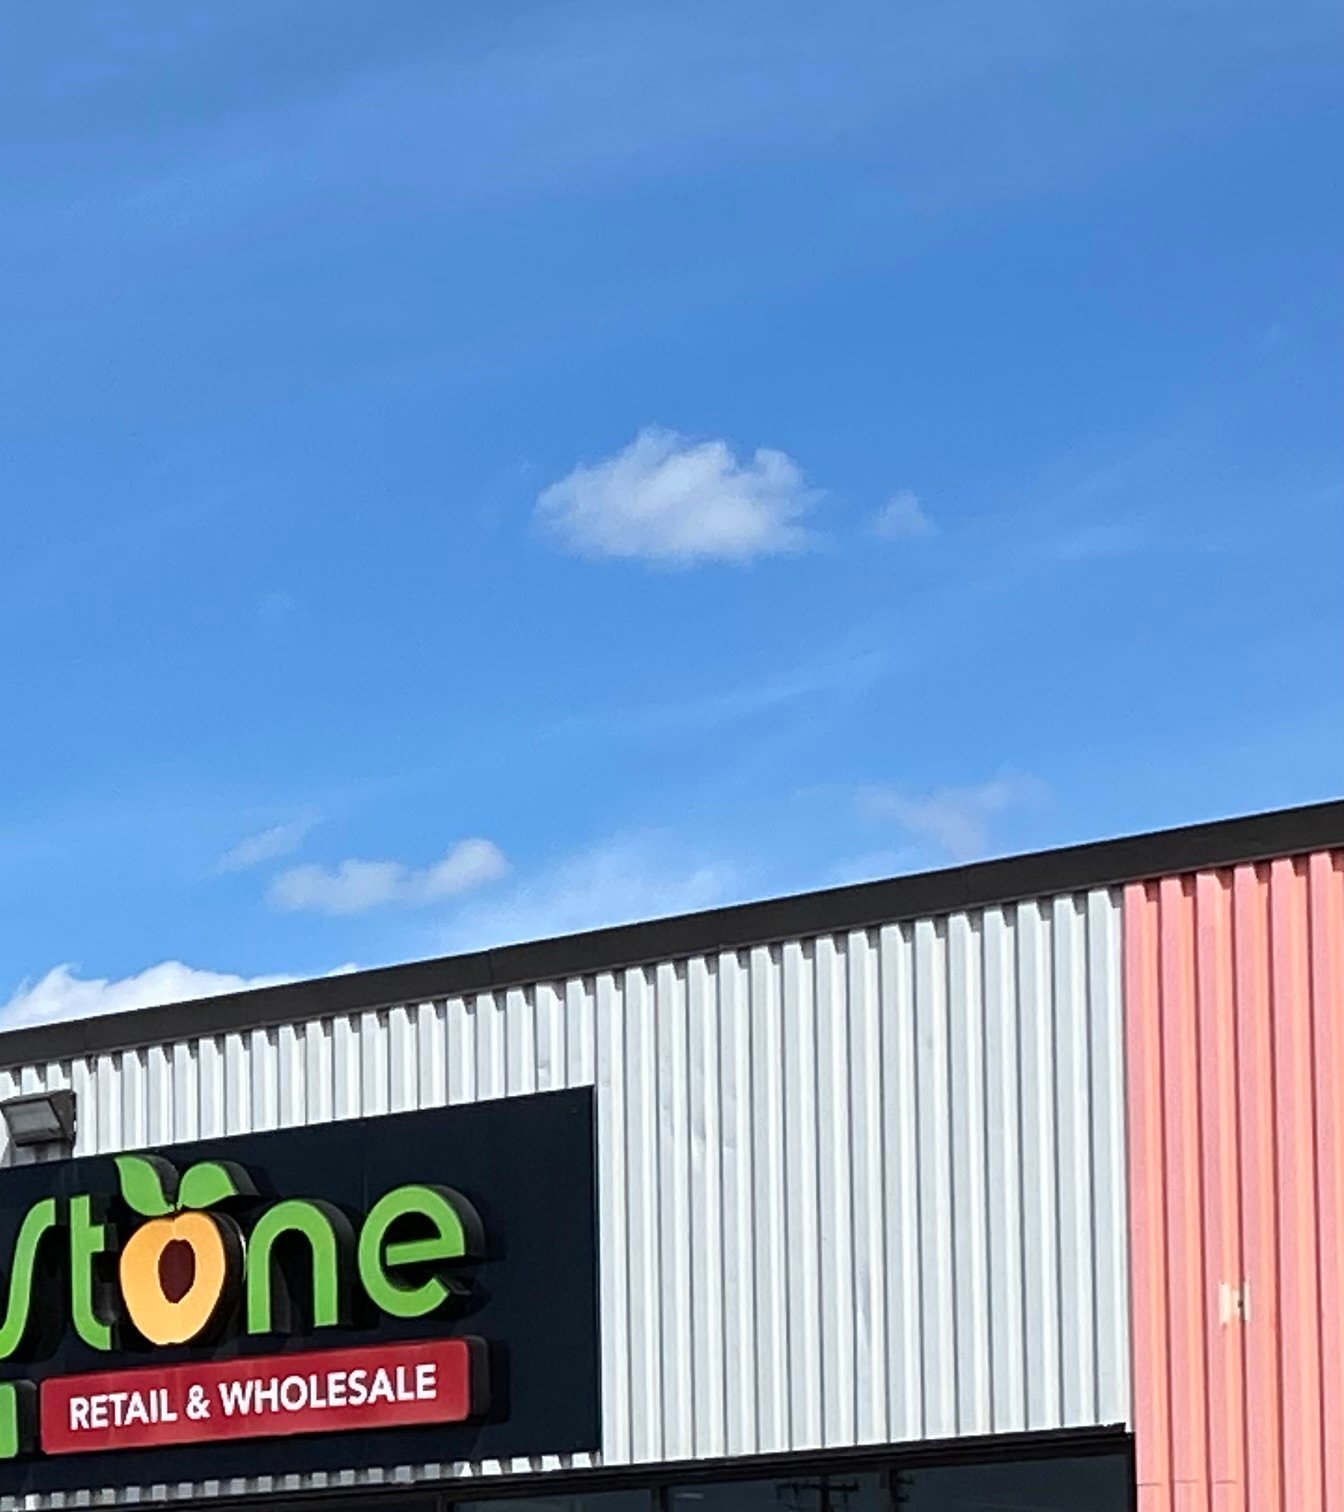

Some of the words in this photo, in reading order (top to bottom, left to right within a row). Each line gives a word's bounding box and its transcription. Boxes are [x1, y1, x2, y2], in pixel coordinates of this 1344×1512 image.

[69, 1389, 177, 1430] RETAIL
[186, 1384, 210, 1420] &
[219, 1364, 437, 1414] WHOLESALE
